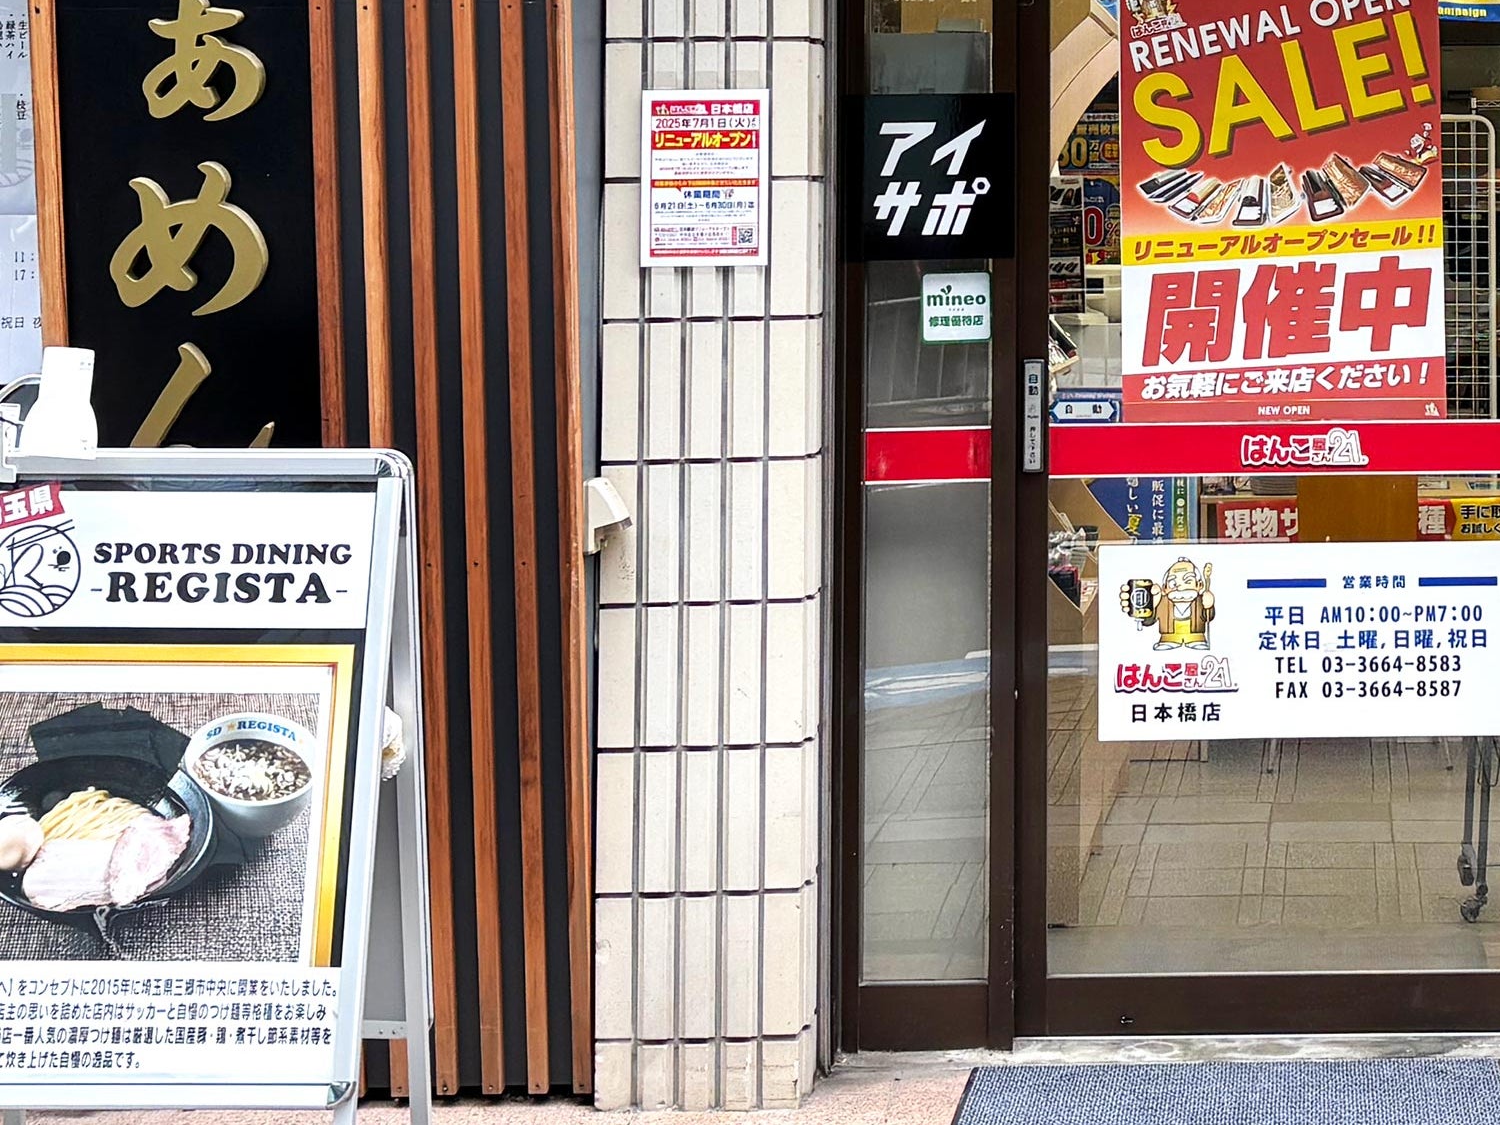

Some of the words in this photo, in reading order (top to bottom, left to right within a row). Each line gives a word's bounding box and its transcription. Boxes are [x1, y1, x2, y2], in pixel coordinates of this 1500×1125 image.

[1437, 6, 1487, 18] ampaign
[1129, 5, 1301, 72] RENEWAL
[1132, 11, 1434, 169] SALE!
[875, 119, 987, 177] アイ
[872, 176, 991, 236] サポ
[926, 284, 986, 306] mineo
[1142, 255, 1432, 367] 開催中
[1140, 362, 1430, 401] お気軽にご来店ください!
[1257, 406, 1280, 415] NEW
[1282, 405, 1311, 415] OPEN
[94, 543, 221, 565] SPORTS
[231, 543, 352, 566] DINING
[1342, 575, 1407, 589] 営業時間
[1265, 606, 1304, 625] 平日
[1258, 630, 1321, 651] 定休日
[1275, 656, 1308, 674] TEL
[1322, 655, 1462, 673] 03-3664-8583
[1275, 681, 1308, 699] FAX
[1322, 680, 1462, 698] 03-3664-8587
[1131, 702, 1221, 723] 日本橋店
[236, 720, 297, 742] REGISTA
